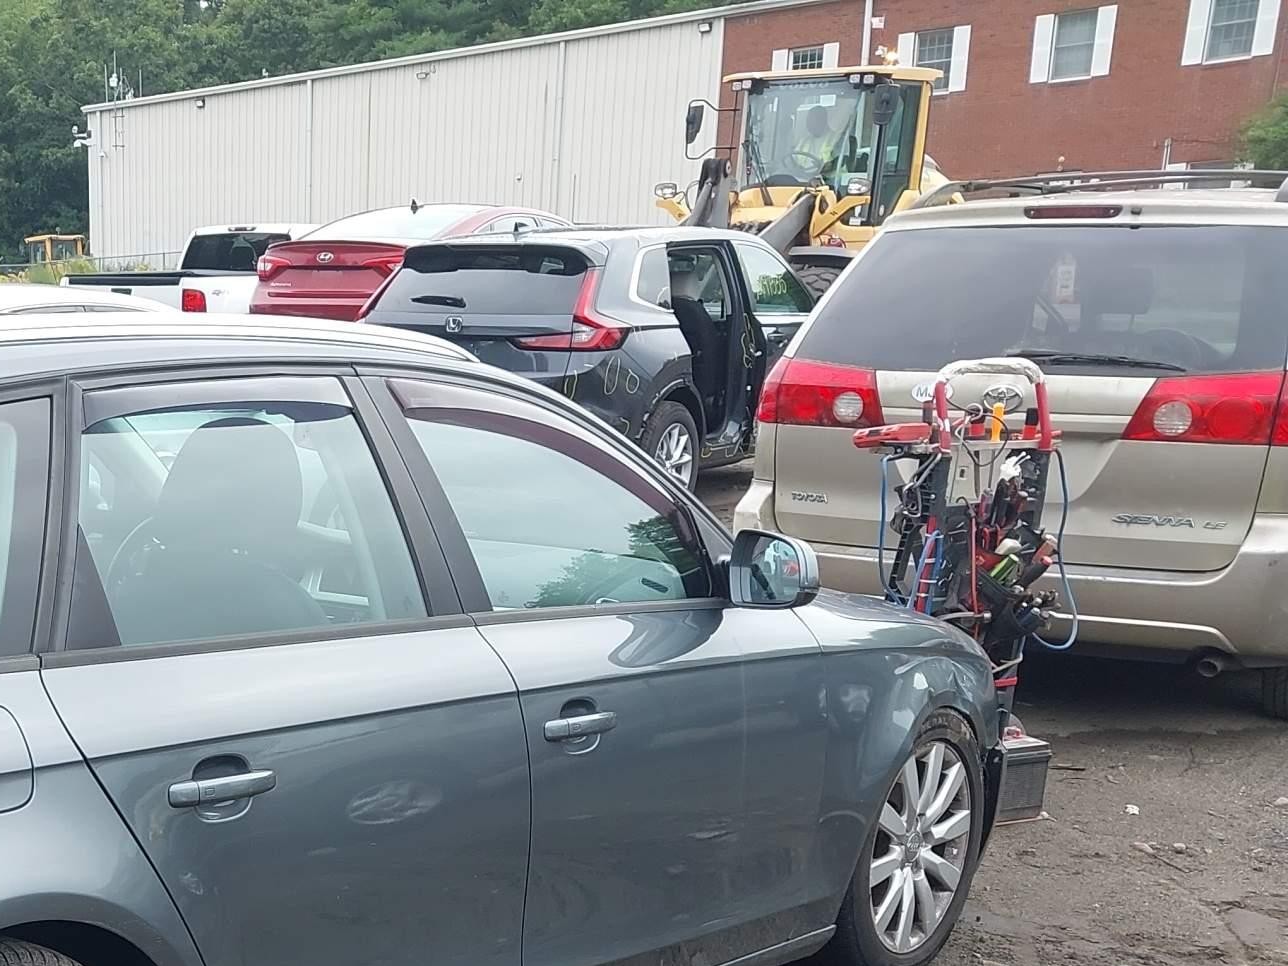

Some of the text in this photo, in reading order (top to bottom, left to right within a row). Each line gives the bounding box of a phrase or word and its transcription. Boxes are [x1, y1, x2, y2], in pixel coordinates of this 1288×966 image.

[791, 490, 828, 504] TOYOTA
[1111, 513, 1228, 530] SIENNA LE
